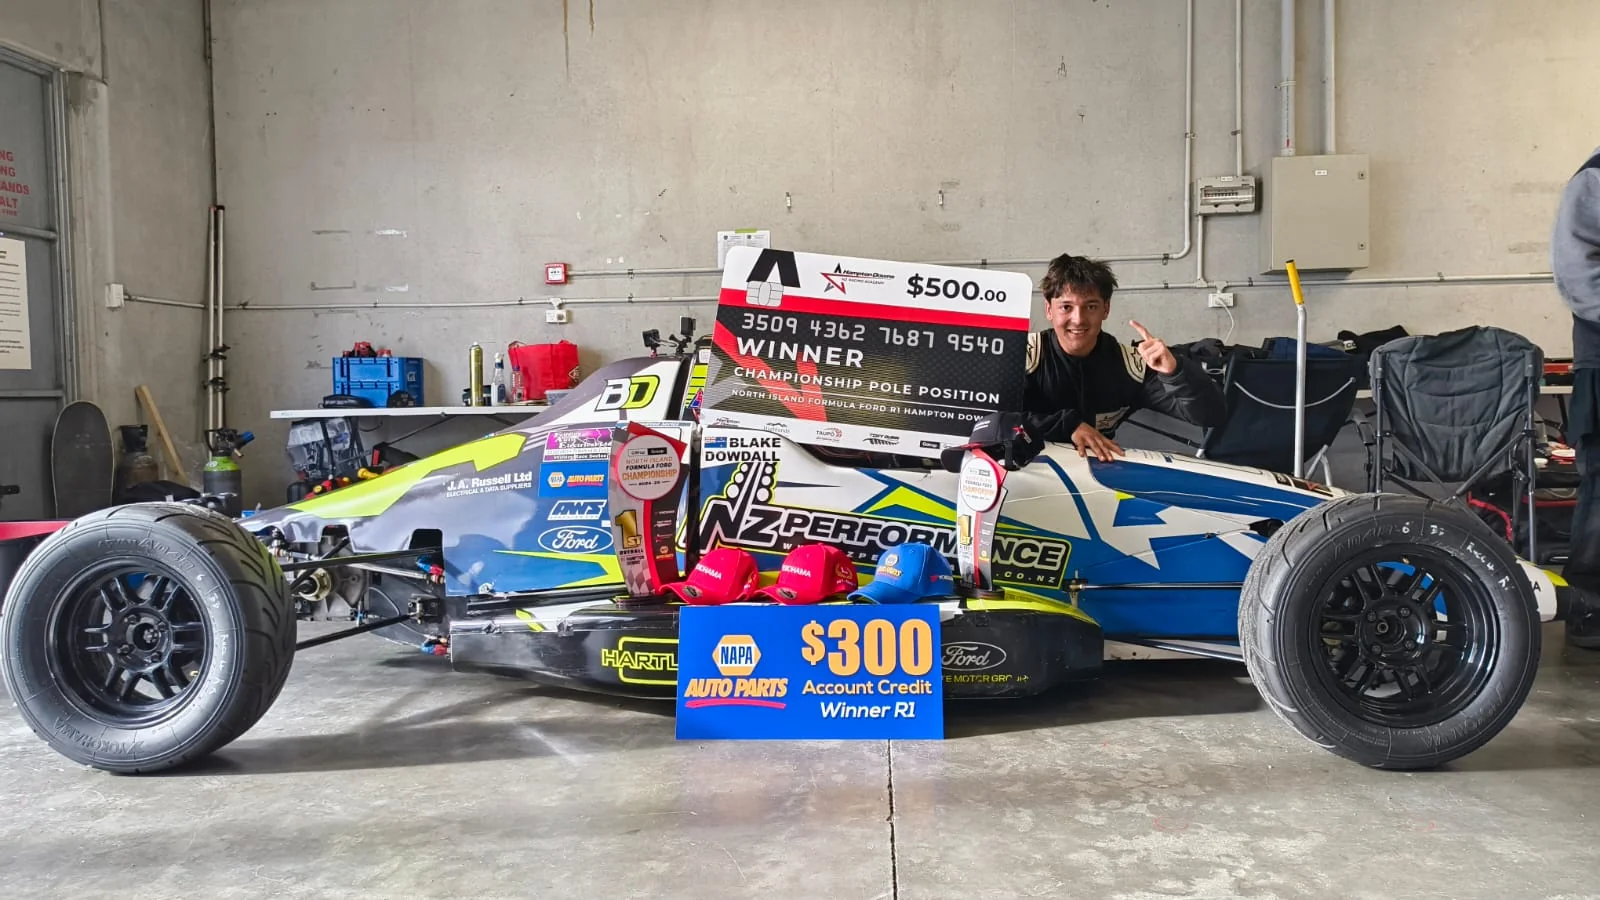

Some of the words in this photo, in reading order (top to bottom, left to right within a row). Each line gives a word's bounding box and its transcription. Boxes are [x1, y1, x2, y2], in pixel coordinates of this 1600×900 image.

[907, 273, 1007, 303] $500.00
[741, 313, 798, 333] 3509
[810, 319, 866, 342] 4362
[879, 326, 935, 349] 7687
[947, 333, 1005, 355] 9540
[736, 336, 864, 368] WINNER
[594, 374, 661, 412] BD
[734, 366, 862, 390] CHAMPIONSHIP
[869, 381, 912, 396] POLE
[918, 386, 1000, 404] POSITION
[731, 389, 765, 399] NORTH
[768, 393, 805, 404] ISLAND
[807, 397, 857, 410] FORMULA
[859, 403, 887, 412] FORD
[904, 408, 955, 420] HAMPTON
[729, 438, 782, 448] BLAKE
[705, 451, 781, 462] DOWDALL
[447, 480, 469, 491] J.A.
[471, 475, 511, 488] Russell
[514, 471, 532, 482] Ltd
[622, 469, 678, 480] CHAMPIONSHIP
[446, 487, 479, 497] ELECTRICAL
[499, 483, 532, 491] SUPPLIERS
[552, 529, 600, 550] Ford
[720, 646, 753, 664] NAPA
[801, 618, 933, 676] $300
[941, 645, 991, 666] Ford
[602, 648, 679, 671] HARTL
[684, 678, 733, 698] AUTO
[733, 678, 789, 698] PARTS
[802, 680, 874, 694] Account
[877, 680, 933, 694] Credit
[820, 701, 891, 718] Winner
[893, 702, 916, 718] R1
